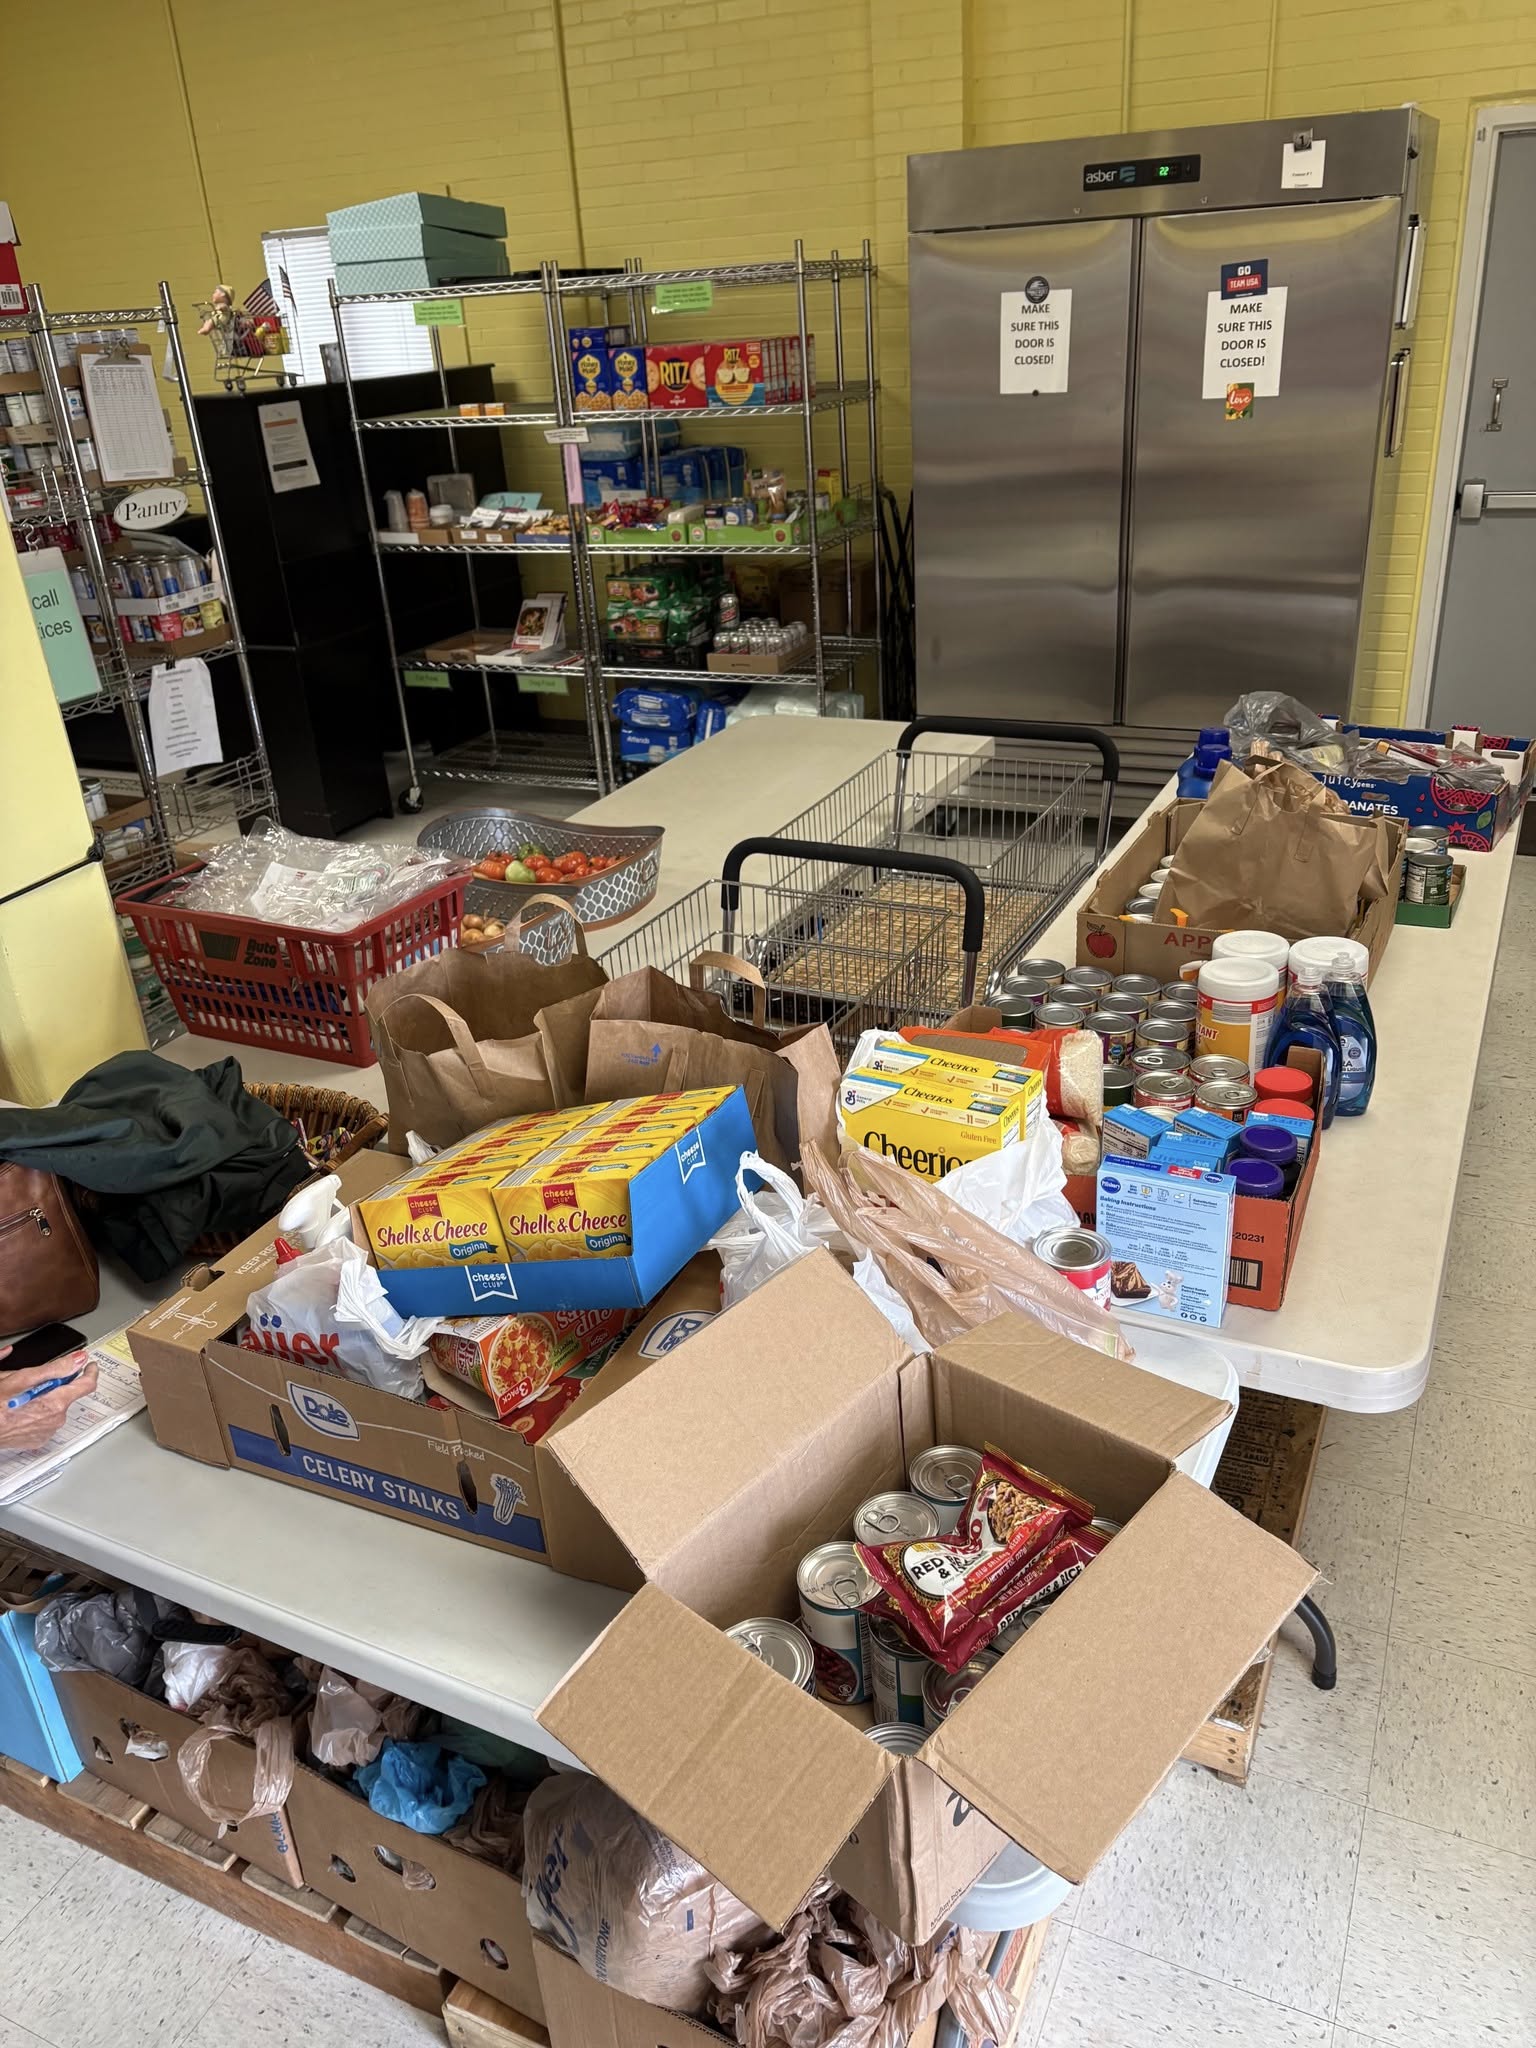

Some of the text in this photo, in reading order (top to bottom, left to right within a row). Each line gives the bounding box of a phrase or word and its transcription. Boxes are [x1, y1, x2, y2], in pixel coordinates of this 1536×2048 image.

[1086, 169, 1118, 183] asber
[1159, 166, 1170, 176] 22
[1237, 265, 1251, 276] GO
[1230, 276, 1259, 289] TEAM USA
[1021, 304, 1050, 314] MAKE
[1230, 302, 1263, 314] MAKE
[1010, 320, 1060, 332] SURE THIS
[1217, 319, 1272, 333] SURE THIS
[1015, 338, 1055, 348] DOOR IS
[1221, 338, 1266, 351] DOOR IS
[724, 347, 741, 362] RITZ
[1014, 355, 1054, 365] CLOSED!
[1220, 356, 1265, 368] CLOSED!
[659, 361, 690, 385] RITZ
[124, 497, 183, 521] Pantry
[32, 588, 60, 610] call
[1321, 774, 1358, 790] juicy
[247, 939, 277, 955] Auto
[1164, 932, 1212, 950] APP
[244, 955, 277, 968] Zone
[930, 1056, 980, 1075] Cheerios
[903, 1086, 955, 1105] Cheerios
[960, 1130, 997, 1145] Gluten Free
[681, 1140, 700, 1162] cheese
[1101, 1180, 1121, 1190] Pillsbury
[544, 1190, 575, 1199] cheese
[410, 1199, 439, 1209] cheese
[1120, 1199, 1156, 1211] Instructions
[509, 1210, 628, 1236] Shells & Cheese
[377, 1218, 488, 1248] Shells & Cheese
[452, 1242, 488, 1257] Original
[589, 1234, 627, 1250] Original
[234, 1256, 261, 1275] KEEP
[472, 1271, 507, 1282] cheese
[239, 1313, 341, 1373] eijer
[503, 1386, 523, 1404] PACK
[303, 1394, 350, 1428] Dole
[427, 1440, 450, 1457] Field
[302, 1455, 460, 1521] CELERY STALKS
[910, 1556, 943, 1581] RED
[939, 1568, 951, 1579] &
[1060, 1565, 1083, 1590] RICE
